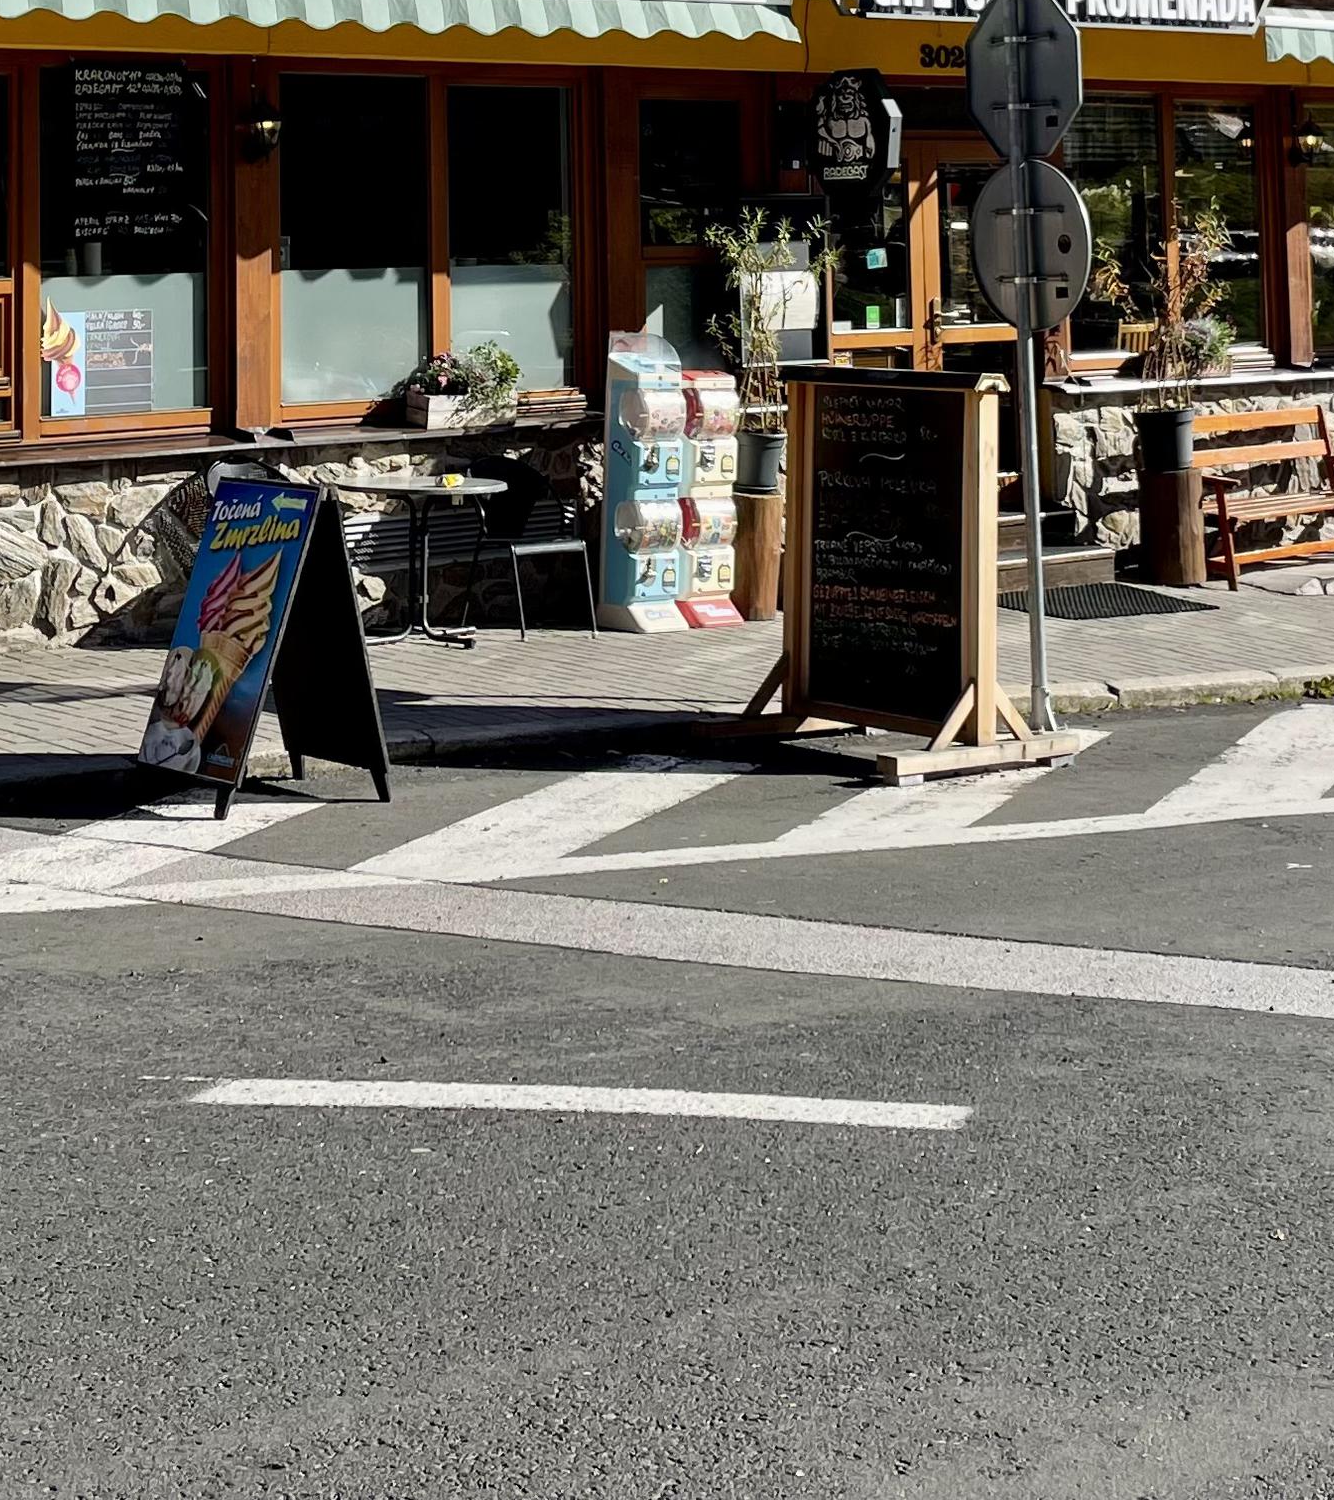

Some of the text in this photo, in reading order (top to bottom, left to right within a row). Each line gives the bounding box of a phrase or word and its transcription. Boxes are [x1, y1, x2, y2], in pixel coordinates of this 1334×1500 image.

[823, 165, 869, 180] RADEGAST
[211, 493, 264, 522] Točená
[209, 514, 301, 551] Zmrzlina
